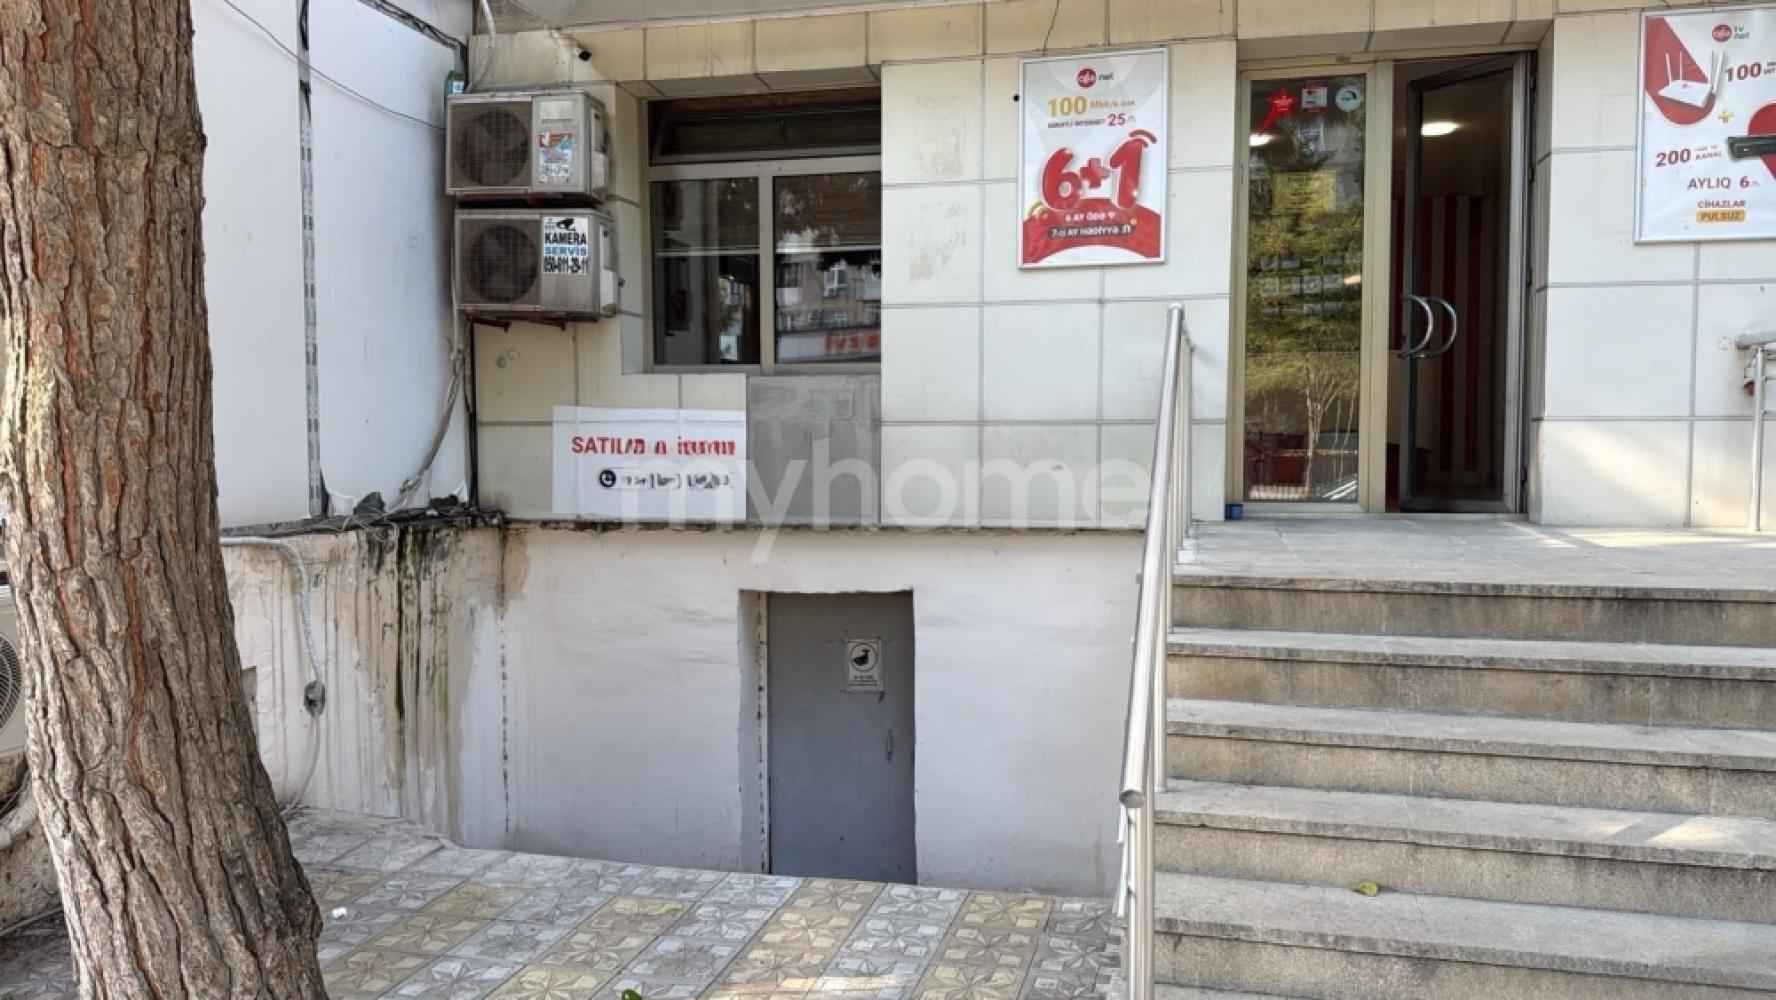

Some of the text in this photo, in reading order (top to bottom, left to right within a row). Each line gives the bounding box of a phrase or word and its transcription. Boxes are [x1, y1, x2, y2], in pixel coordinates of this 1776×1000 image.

[1726, 62, 1762, 82] 100
[1047, 95, 1087, 117] 100
[1106, 112, 1127, 127] 25
[1655, 148, 1691, 168] 200
[1042, 137, 1146, 210] 6+1
[1687, 176, 1750, 190] AYLIQ 6
[544, 231, 587, 244] KAMERA
